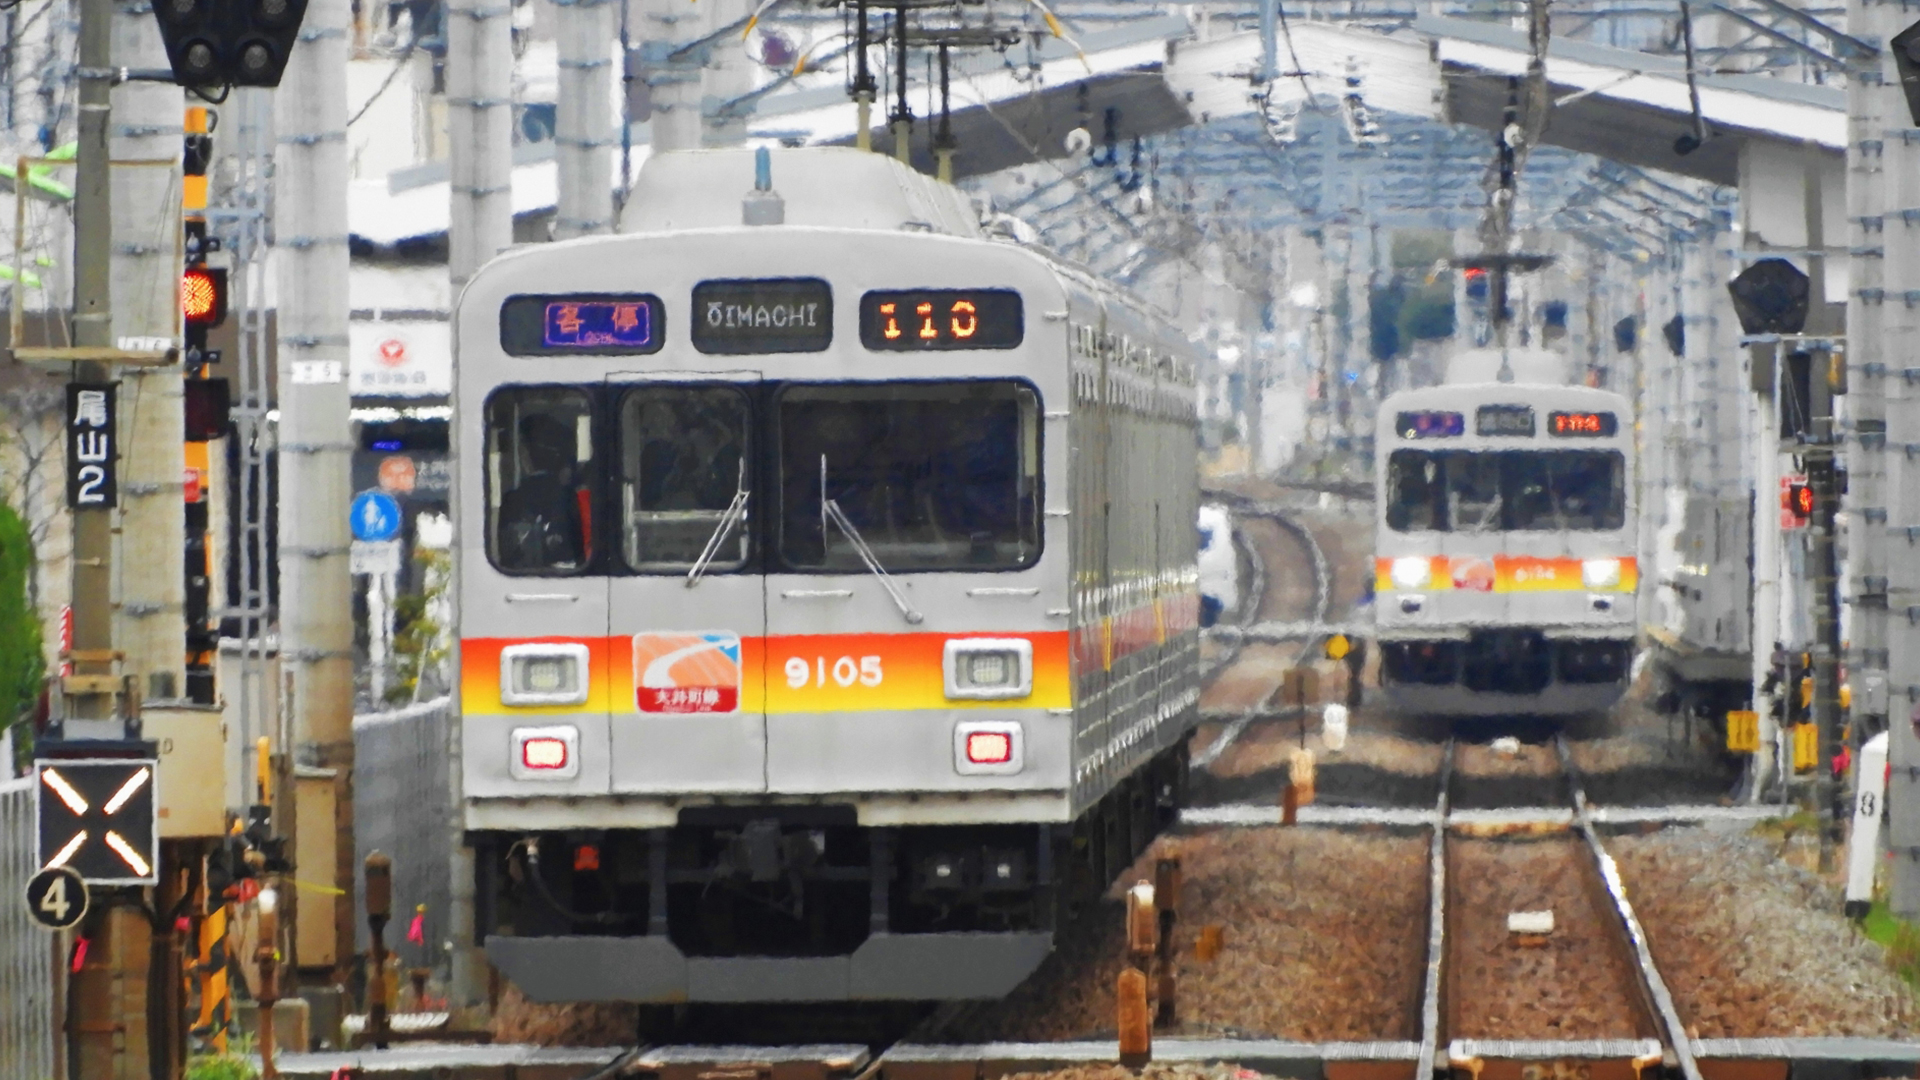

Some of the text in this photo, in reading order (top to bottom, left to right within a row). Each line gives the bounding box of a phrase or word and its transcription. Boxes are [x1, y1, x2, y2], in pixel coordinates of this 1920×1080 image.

[880, 301, 976, 338] 110
[785, 656, 883, 689] 9105
[41, 876, 71, 921] 4
